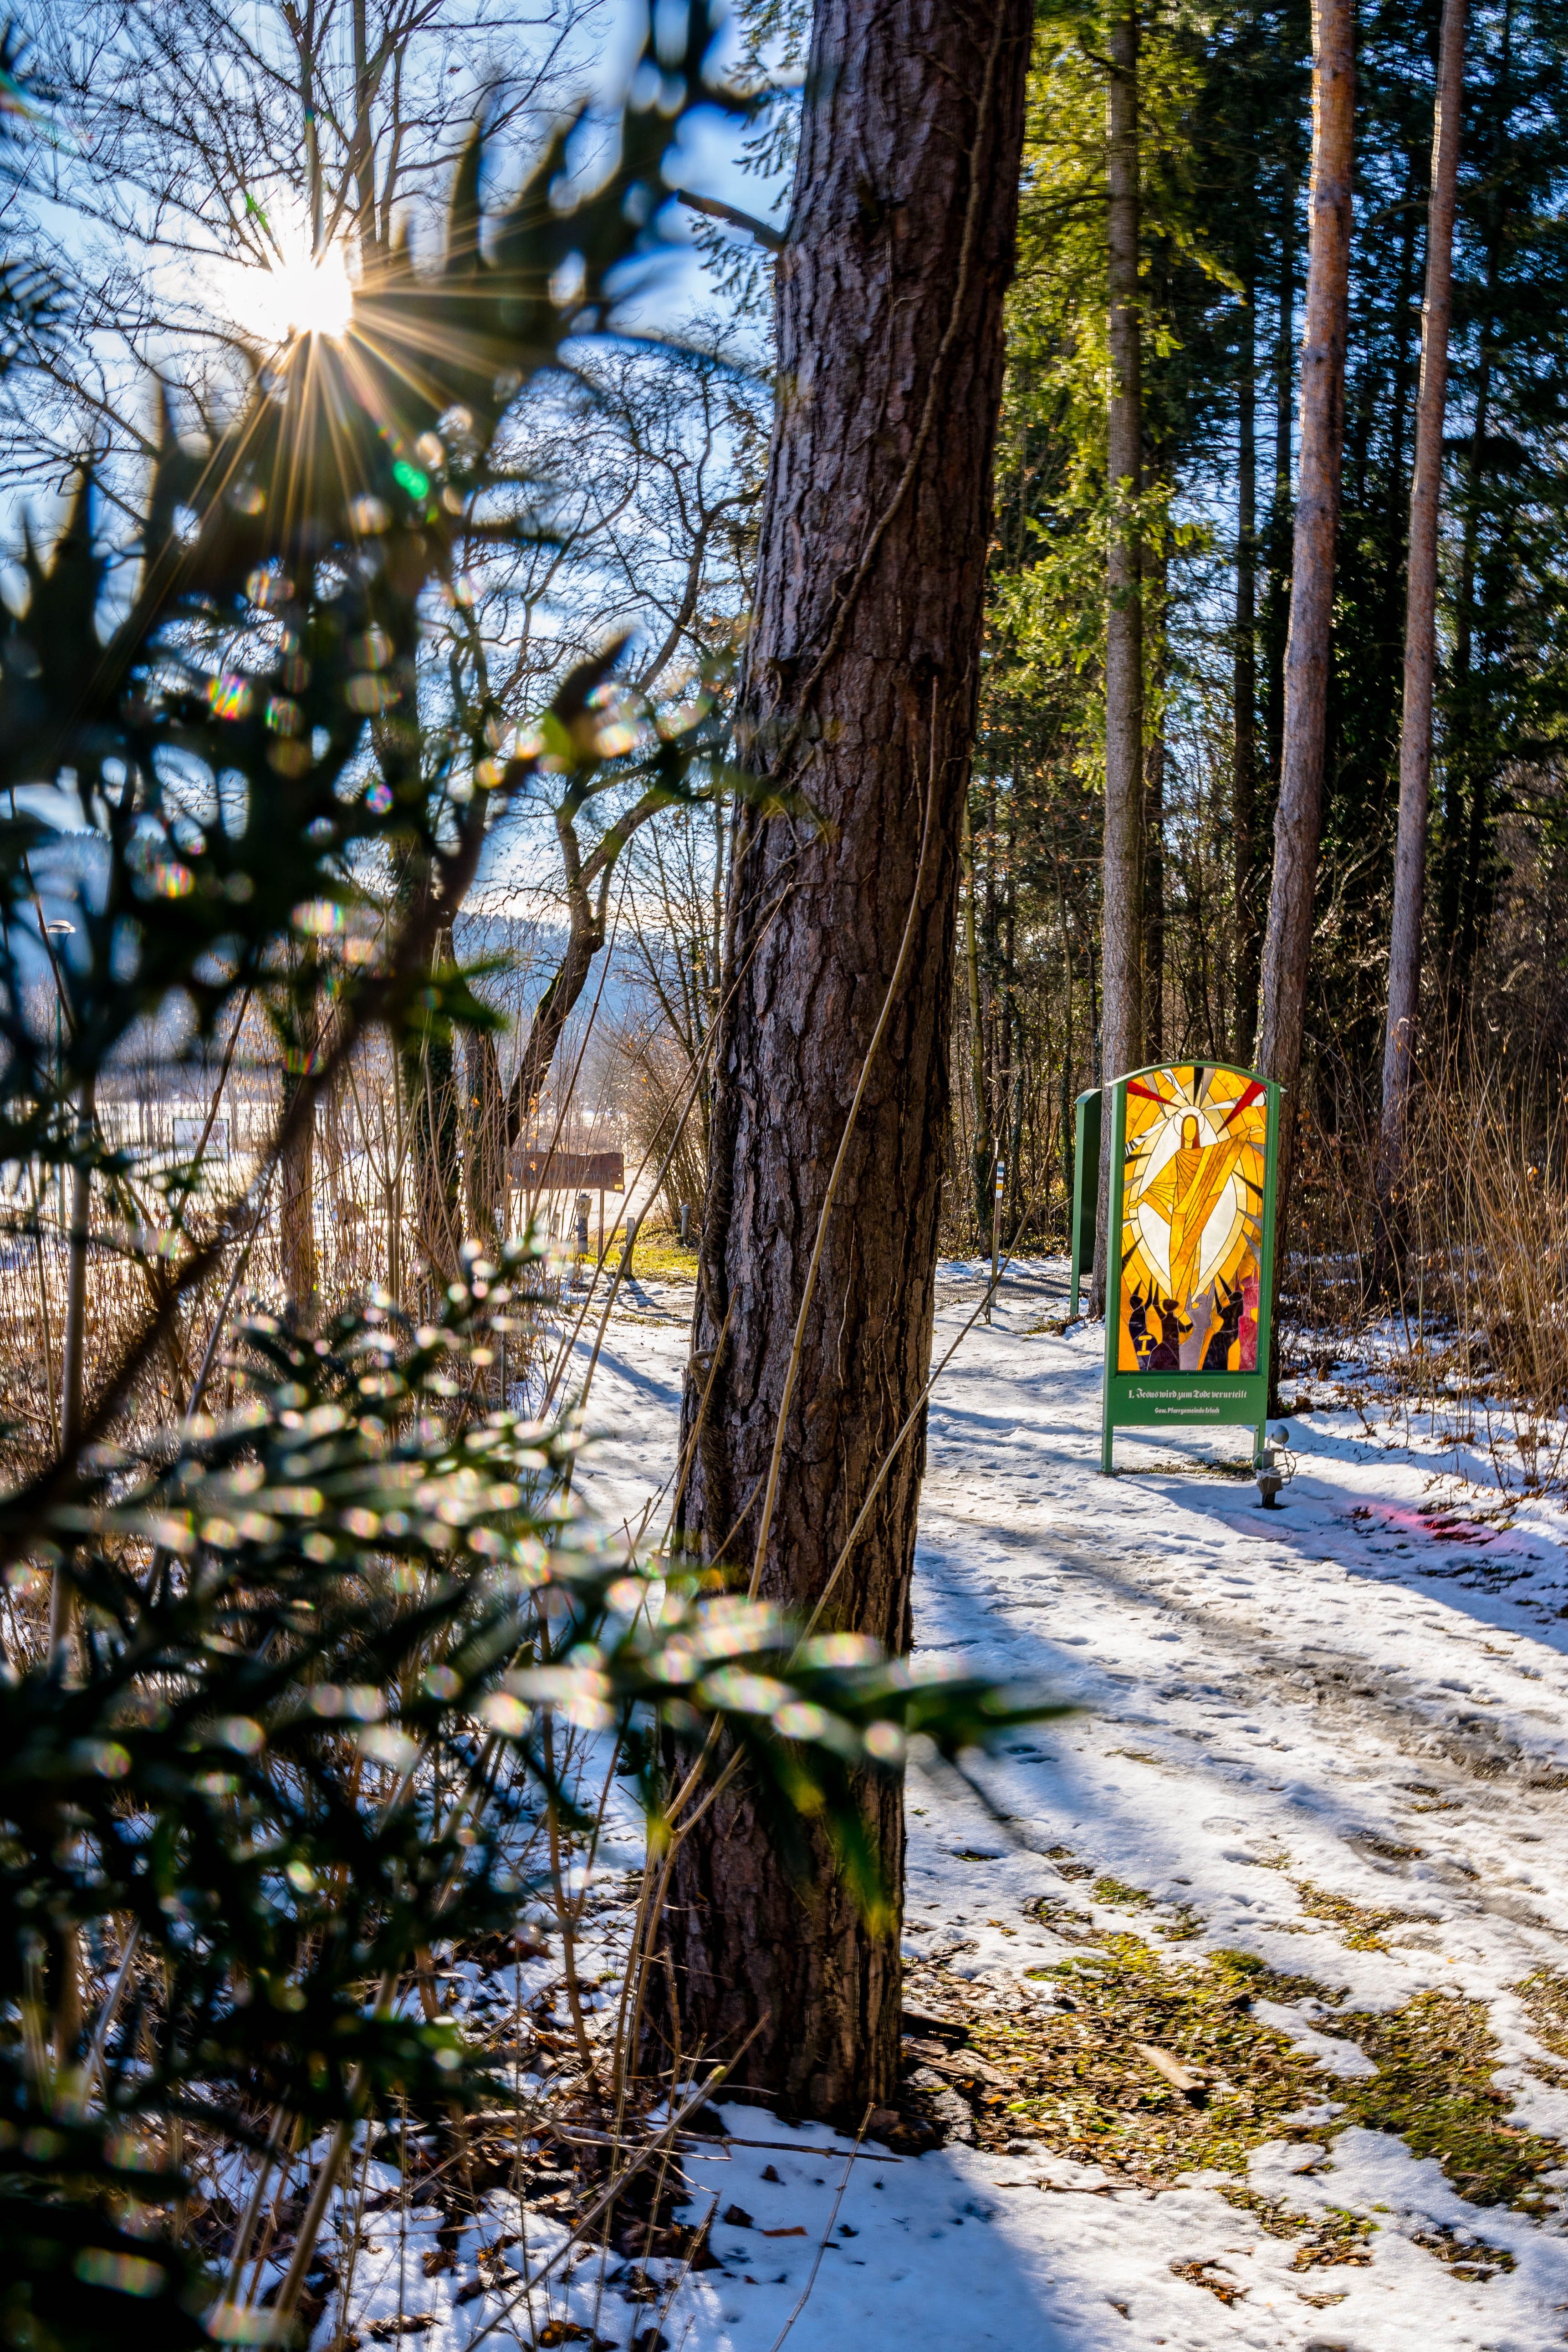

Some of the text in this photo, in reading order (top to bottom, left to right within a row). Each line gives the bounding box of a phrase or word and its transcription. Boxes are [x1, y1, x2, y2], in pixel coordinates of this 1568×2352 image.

[1136, 1388, 1159, 1398] Jesus
[1159, 1390, 1177, 1398] wird
[1177, 1392, 1192, 1400] zum
[1193, 1390, 1210, 1398] Tode
[1211, 1390, 1247, 1398] verurteilt
